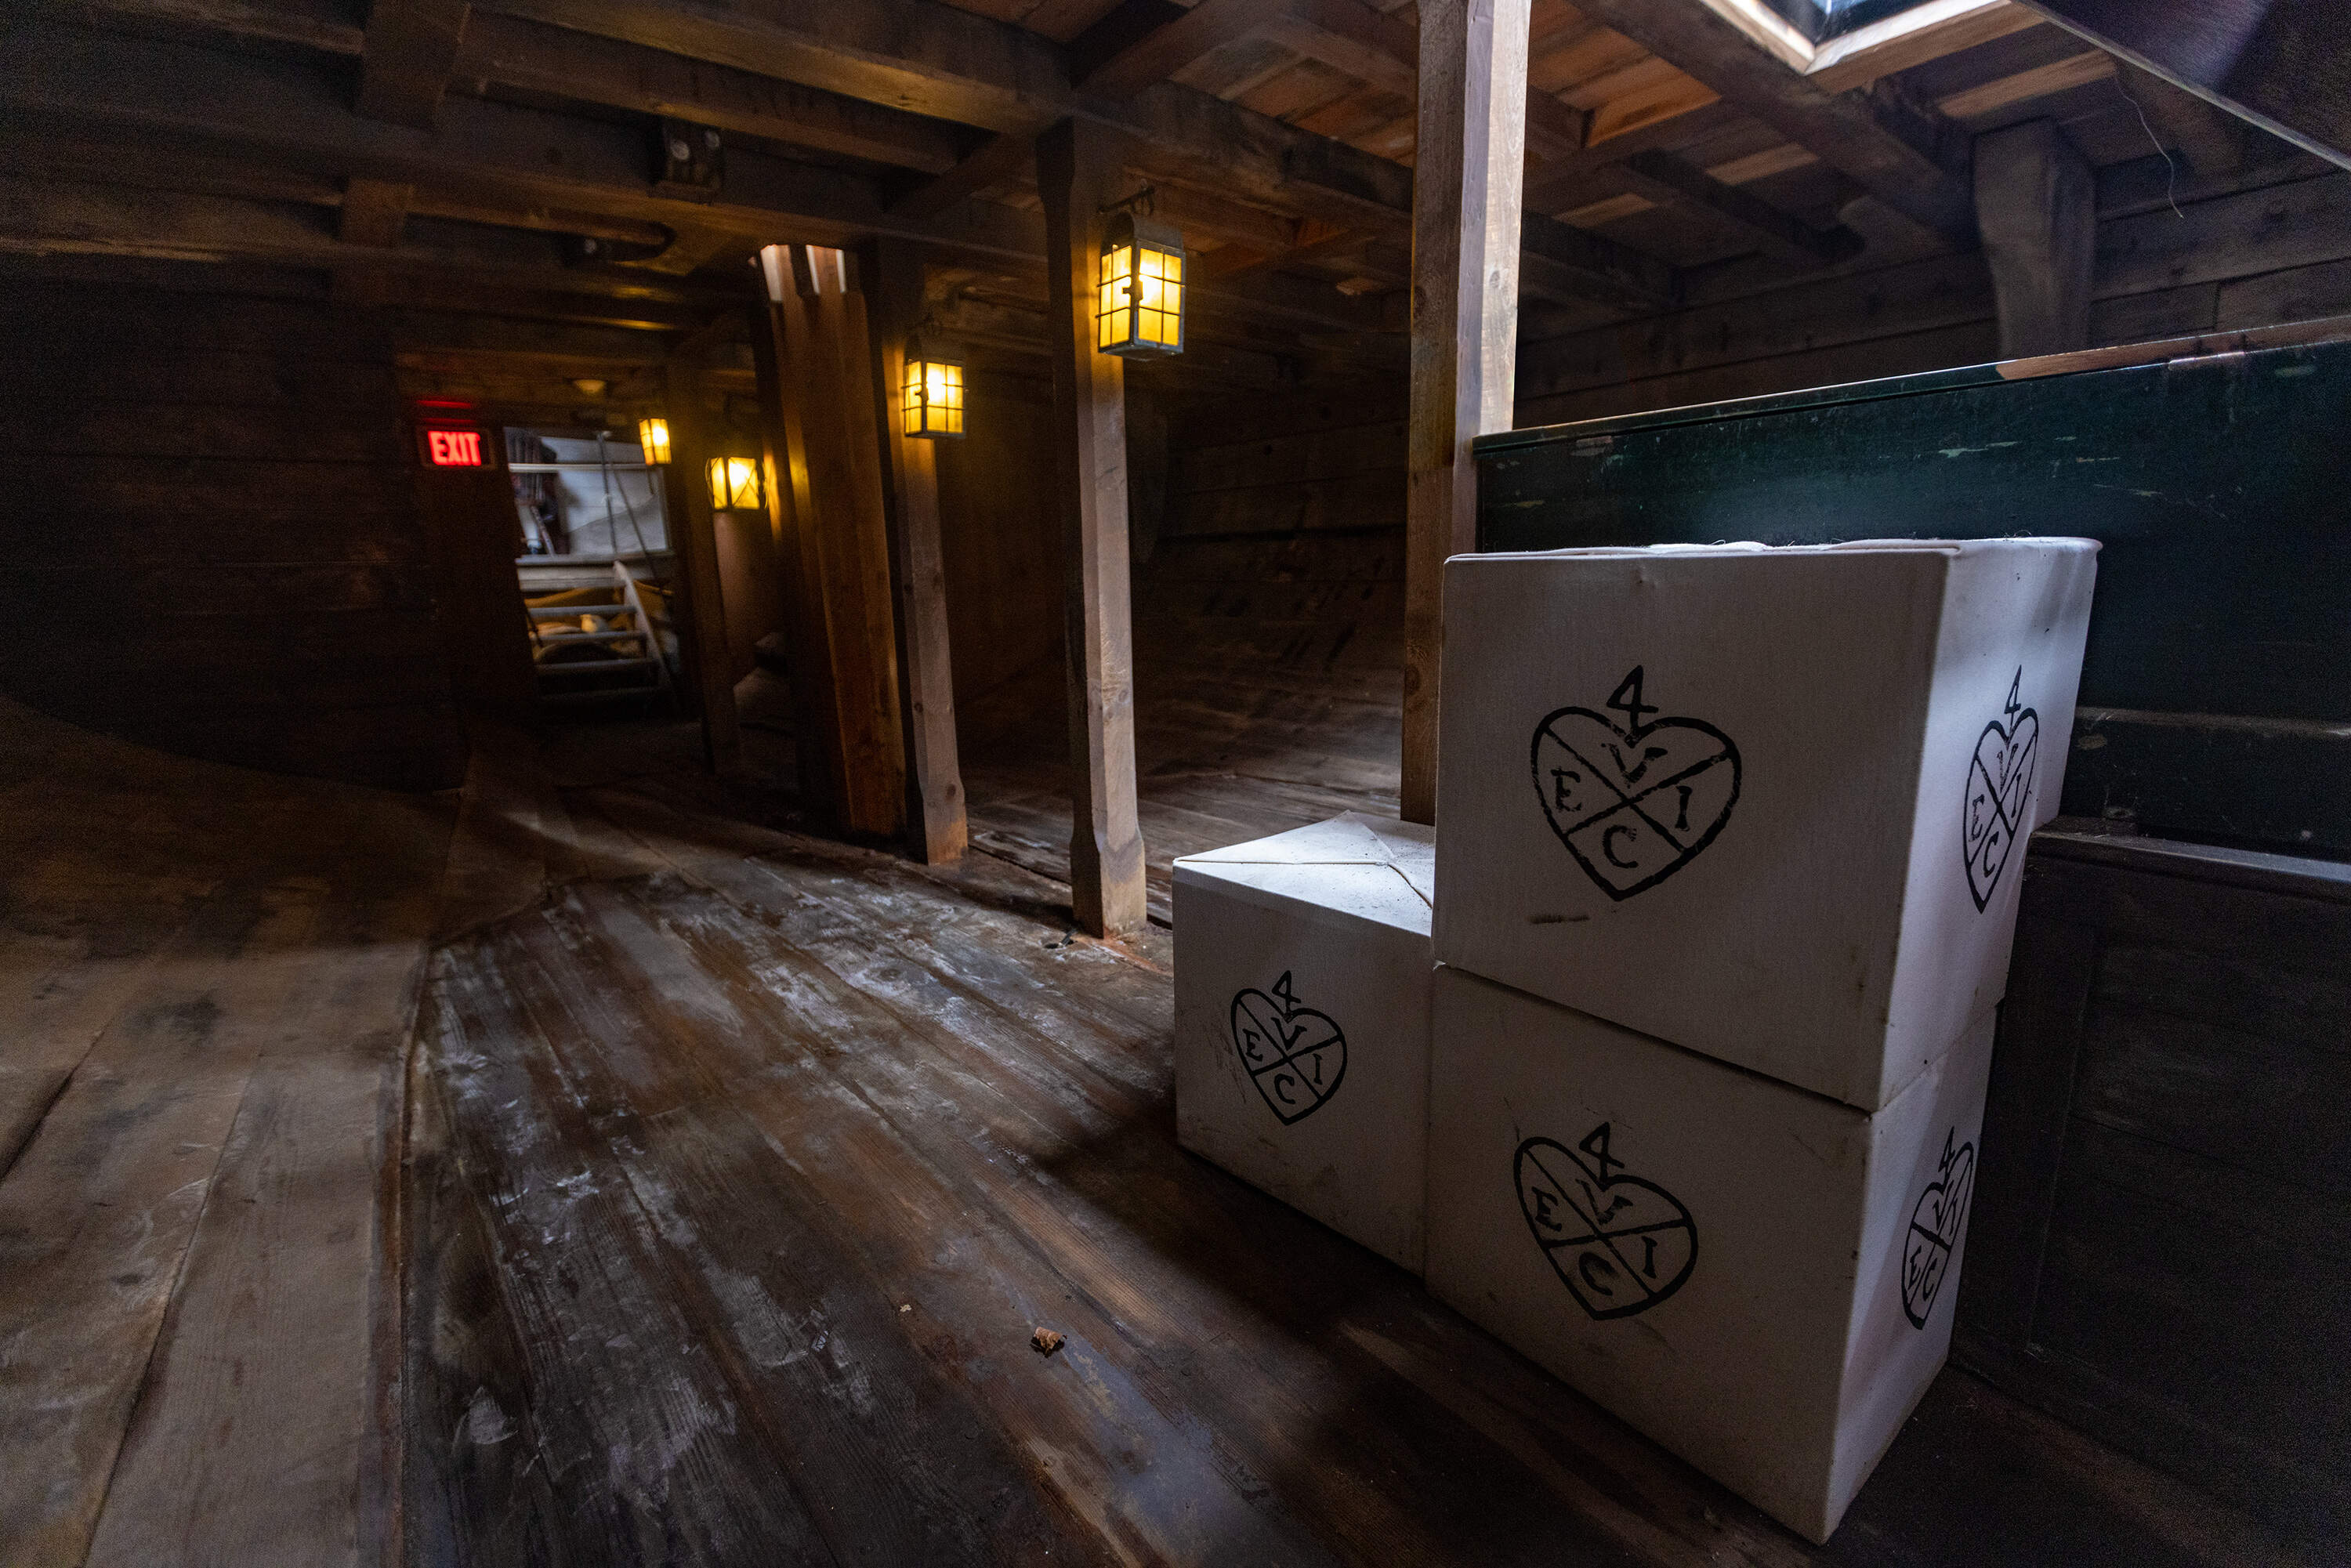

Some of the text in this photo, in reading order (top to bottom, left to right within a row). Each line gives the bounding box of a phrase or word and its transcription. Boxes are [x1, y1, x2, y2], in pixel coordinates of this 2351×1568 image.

[428, 431, 482, 466] EXIT
[1607, 664, 1659, 733] 4
[1601, 743, 1668, 789] V
[1550, 766, 1582, 813] E
[1603, 824, 1639, 868] C
[1271, 970, 1301, 1013] 4
[1242, 1028, 1263, 1062] E
[1270, 1017, 1307, 1051] V
[1273, 1074, 1296, 1104] C
[1578, 1121, 1625, 1182] 4
[1531, 1186, 1562, 1232] E
[1575, 1179, 1633, 1225] V
[1578, 1252, 1617, 1296] C
